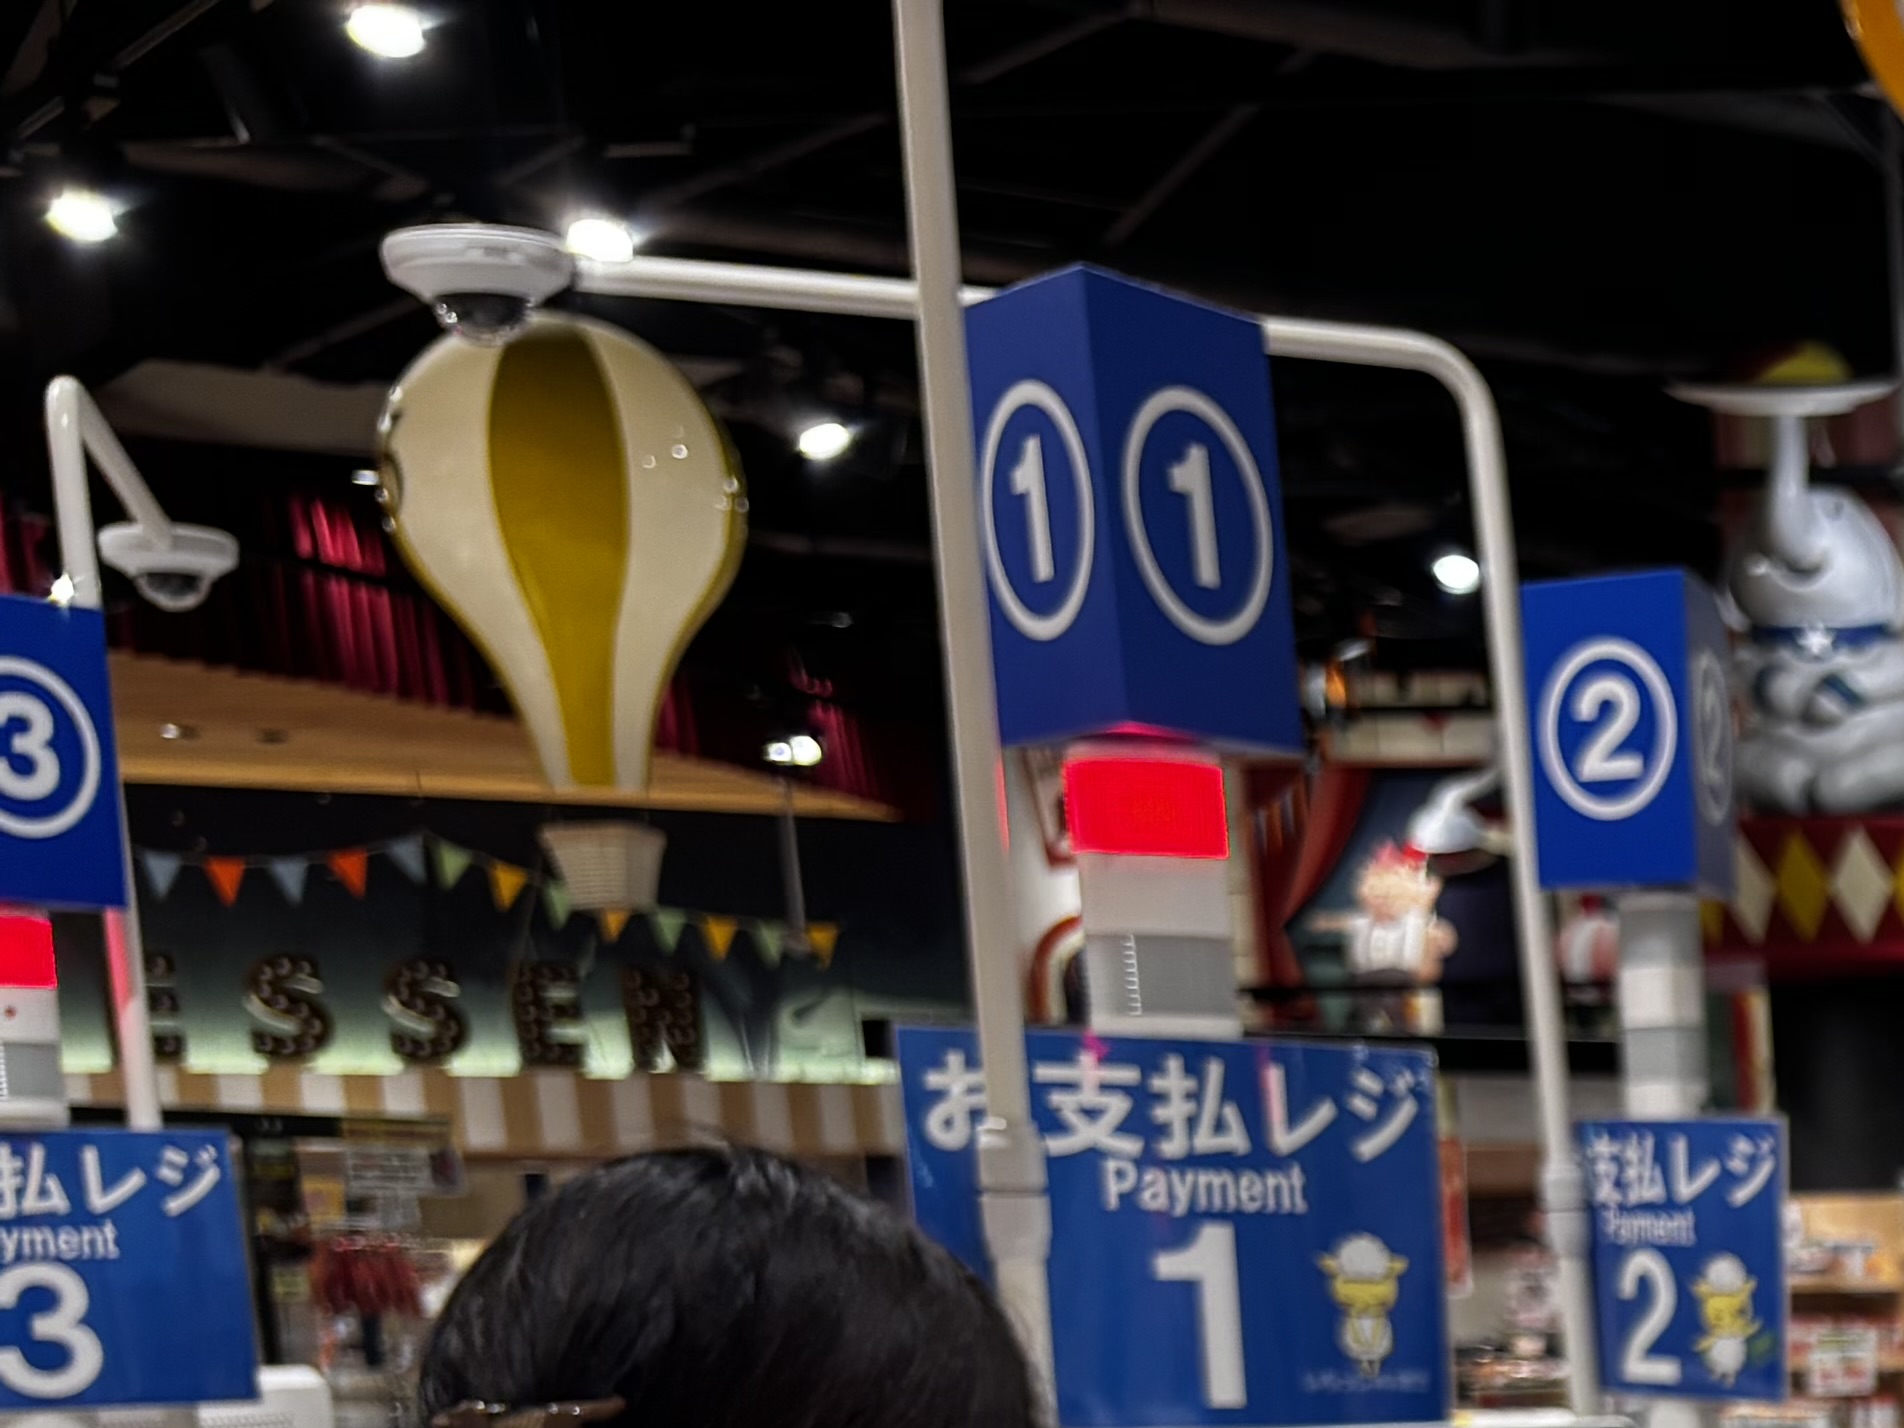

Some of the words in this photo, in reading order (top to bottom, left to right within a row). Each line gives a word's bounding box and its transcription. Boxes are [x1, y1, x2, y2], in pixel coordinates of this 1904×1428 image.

[1102, 1159, 1308, 1218] Payment
[0, 1261, 104, 1400] 3
[1152, 1221, 1248, 1409] 1
[1617, 1247, 1682, 1386] 2
